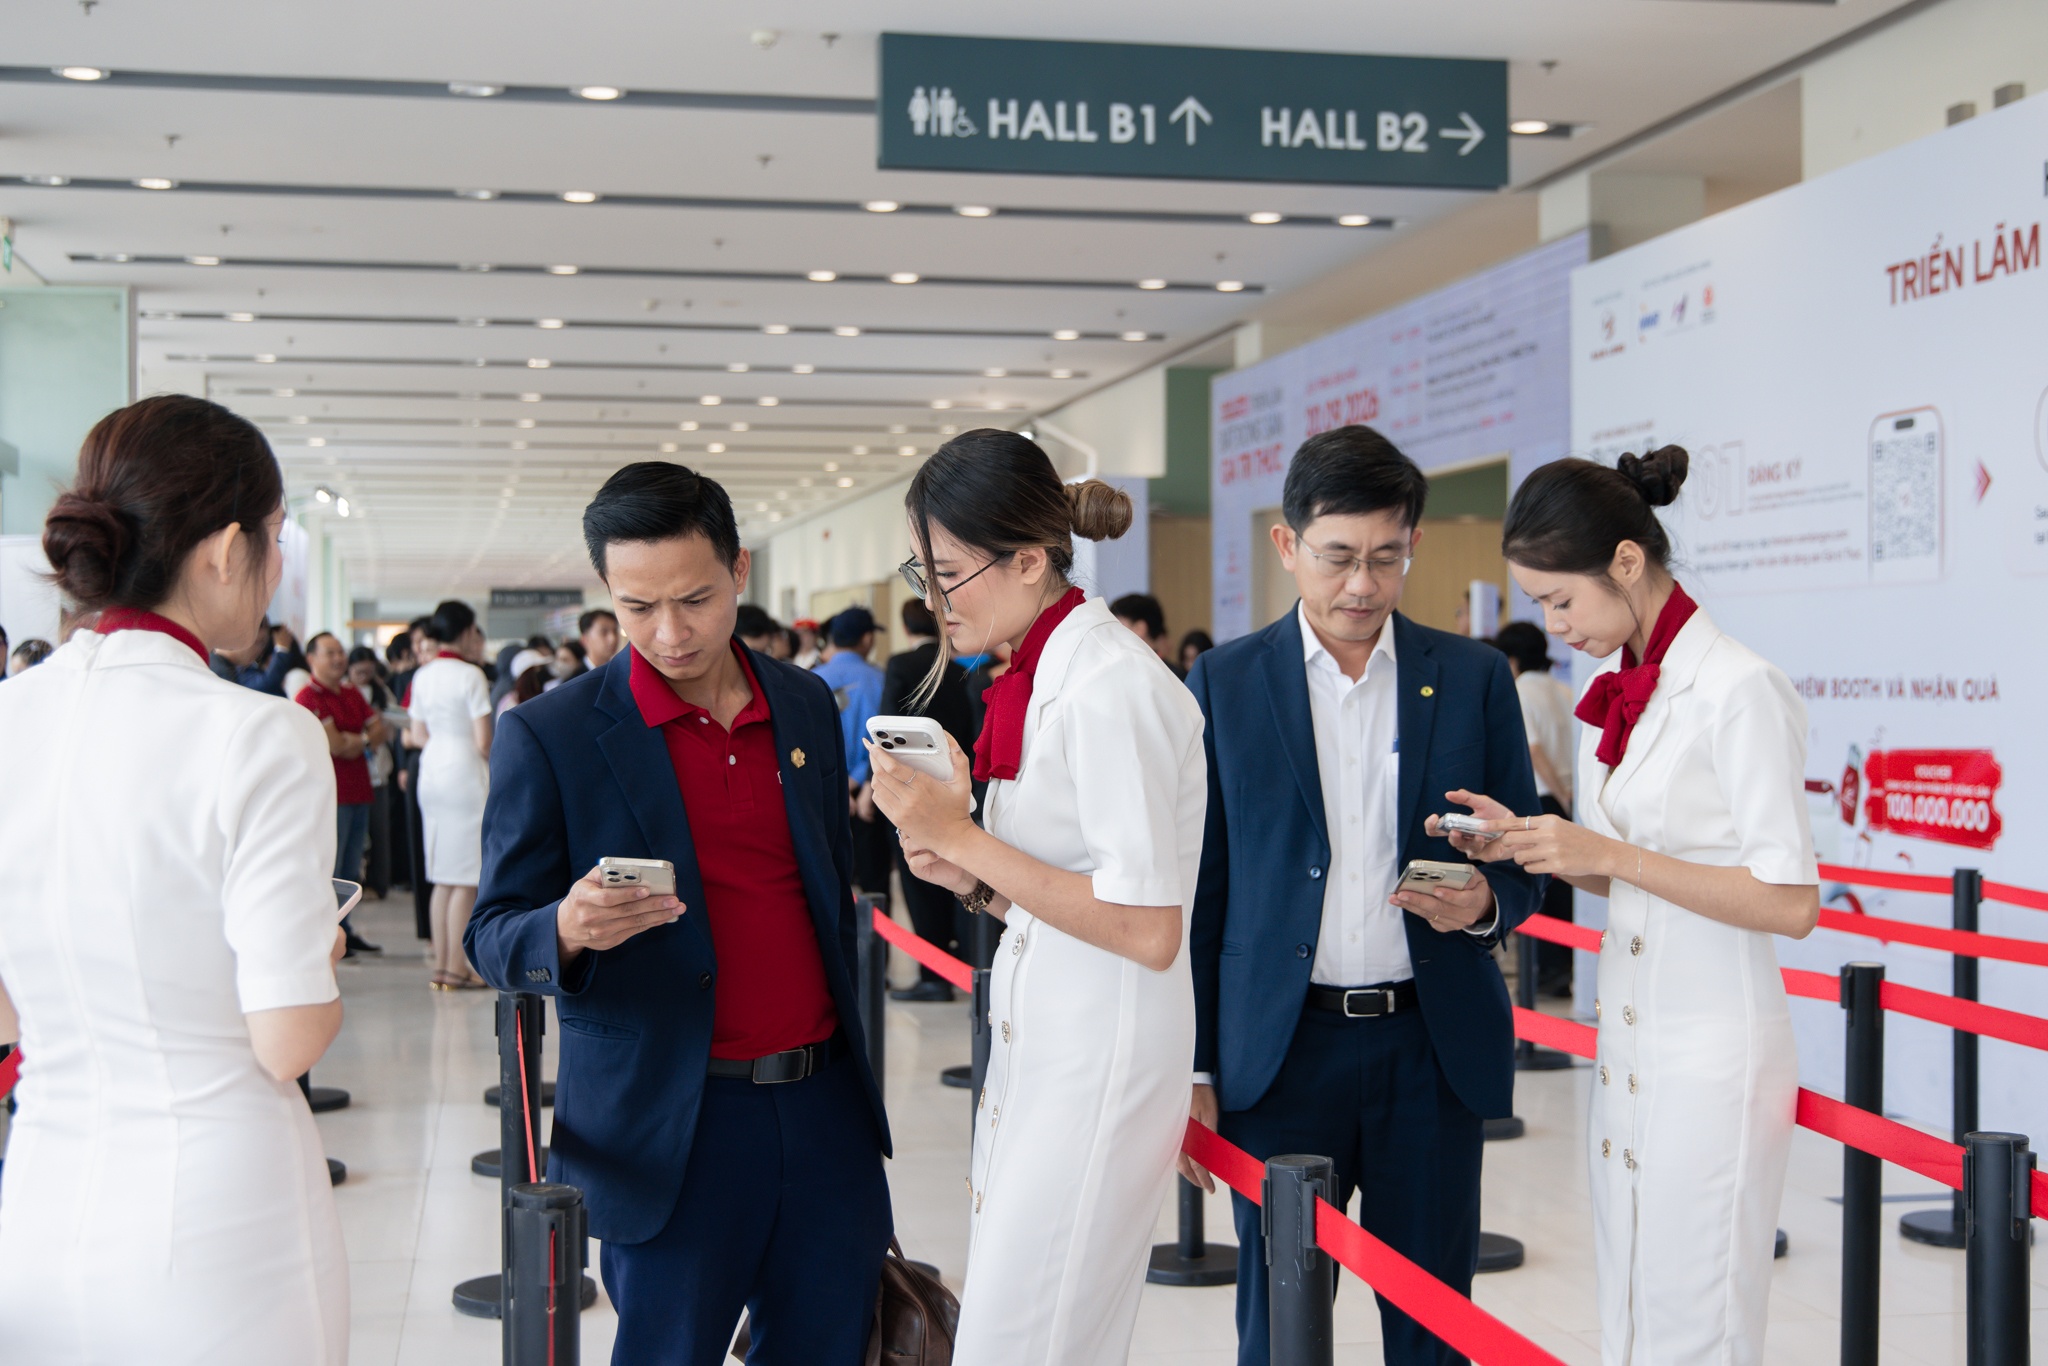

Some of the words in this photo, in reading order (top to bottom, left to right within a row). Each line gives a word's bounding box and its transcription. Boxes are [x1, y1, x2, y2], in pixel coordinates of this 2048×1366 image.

[988, 98, 1098, 143] HALL
[1109, 103, 1156, 145] B1
[1261, 106, 1367, 150] HALL
[1377, 111, 1428, 152] B2
[1885, 232, 1963, 306] TRIỂN
[1974, 220, 2041, 284] LÃM
[1831, 677, 1882, 699] BOOTH
[1885, 792, 1990, 832] 100.000.000
